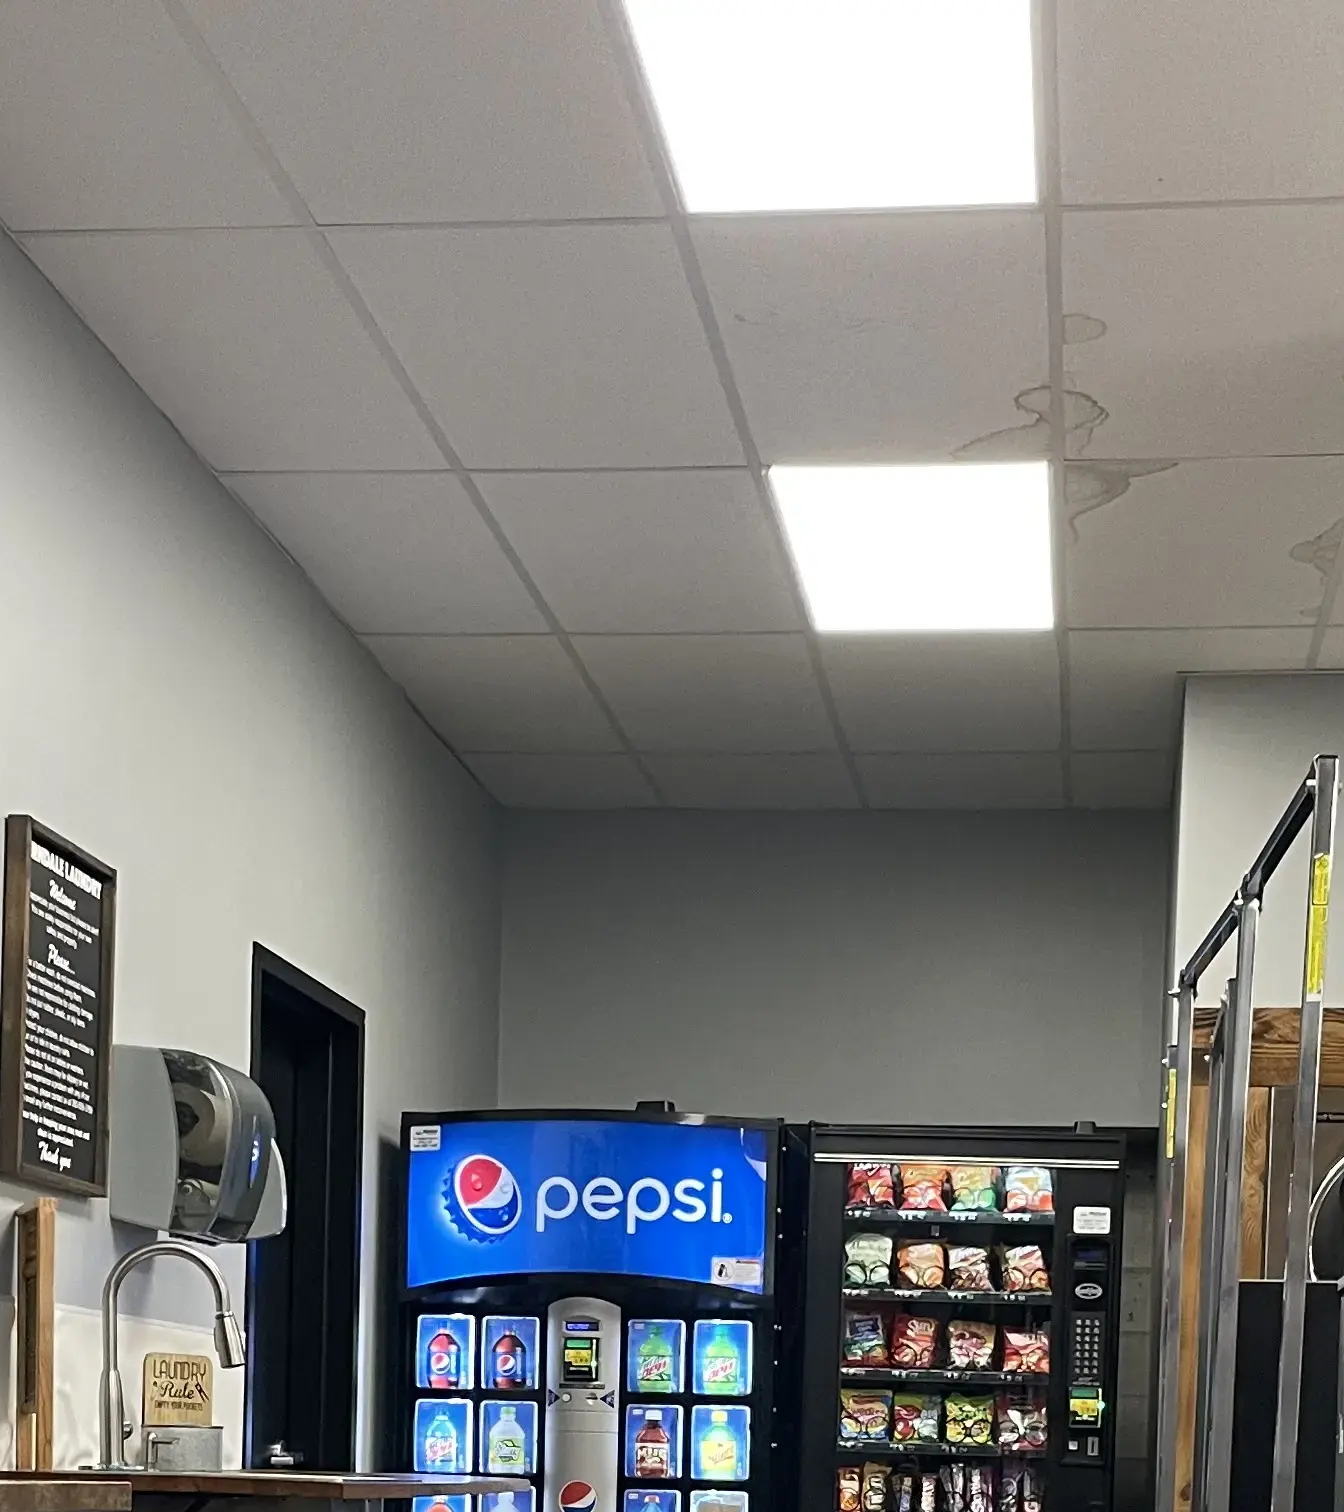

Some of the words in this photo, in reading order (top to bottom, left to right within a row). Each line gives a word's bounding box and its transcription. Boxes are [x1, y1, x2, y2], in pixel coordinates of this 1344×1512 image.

[536, 1167, 723, 1235] pepsi
[153, 1359, 207, 1382] LAUNDRY
[160, 1380, 196, 1400] Rule
